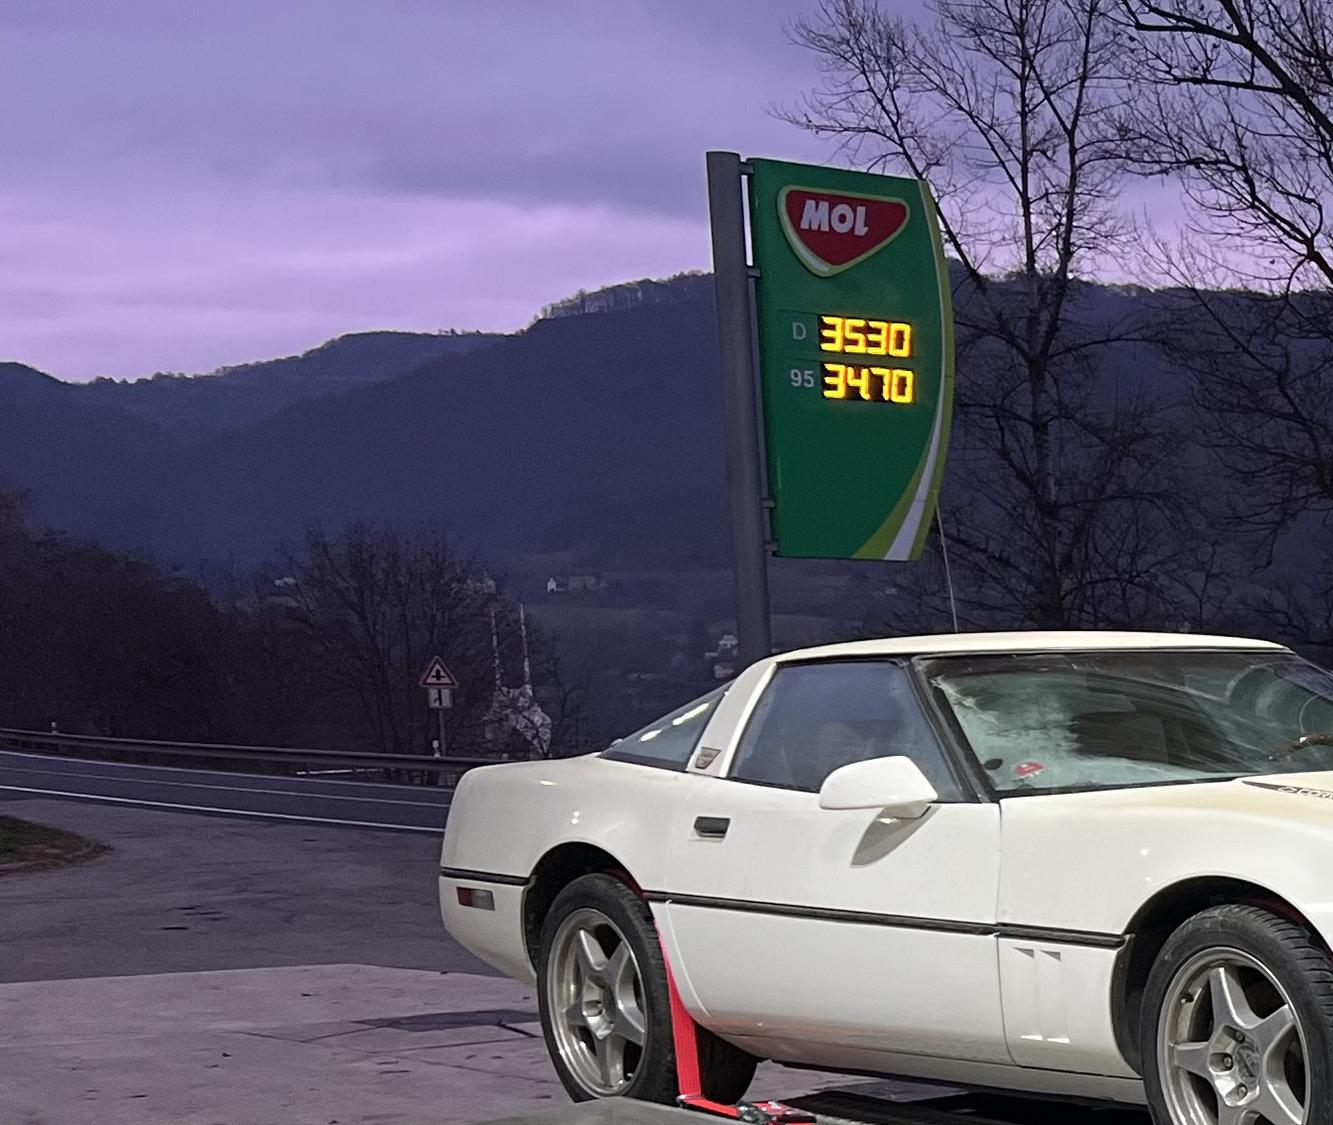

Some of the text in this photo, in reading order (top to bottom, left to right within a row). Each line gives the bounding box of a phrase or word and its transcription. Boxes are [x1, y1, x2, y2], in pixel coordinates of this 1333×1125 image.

[800, 199, 870, 236] MOL
[792, 315, 911, 357] D 3530
[790, 363, 914, 404] 95 3470
